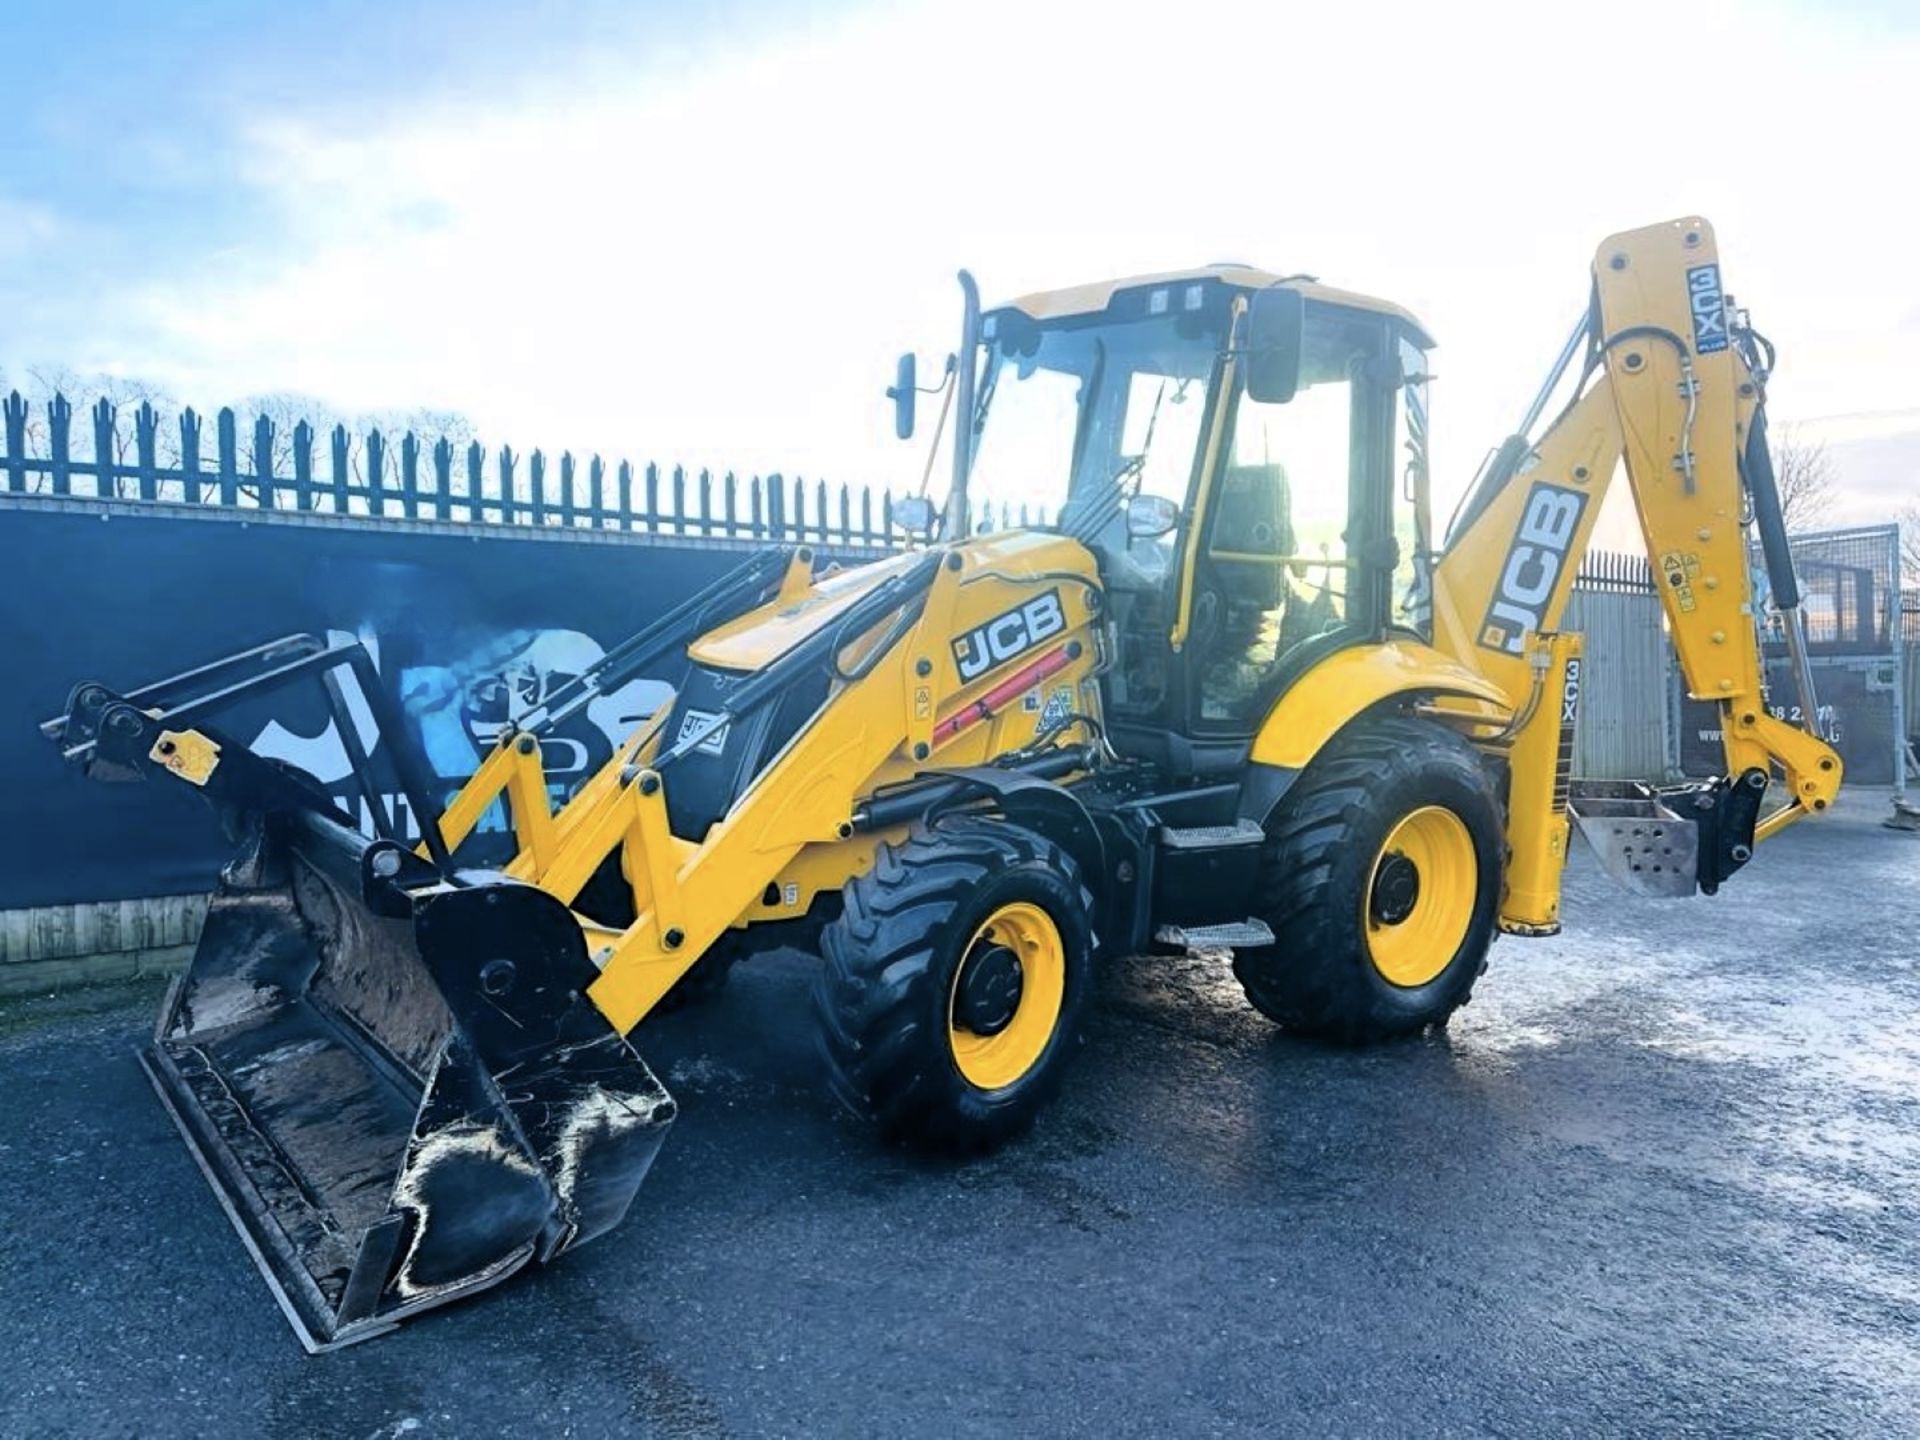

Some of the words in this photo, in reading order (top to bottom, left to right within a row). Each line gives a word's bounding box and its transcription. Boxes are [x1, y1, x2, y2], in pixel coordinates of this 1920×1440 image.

[1689, 266, 1724, 334] 3CX
[1492, 489, 1581, 653] JCB
[960, 594, 1064, 677] JCB
[1562, 660, 1581, 722] 3CX
